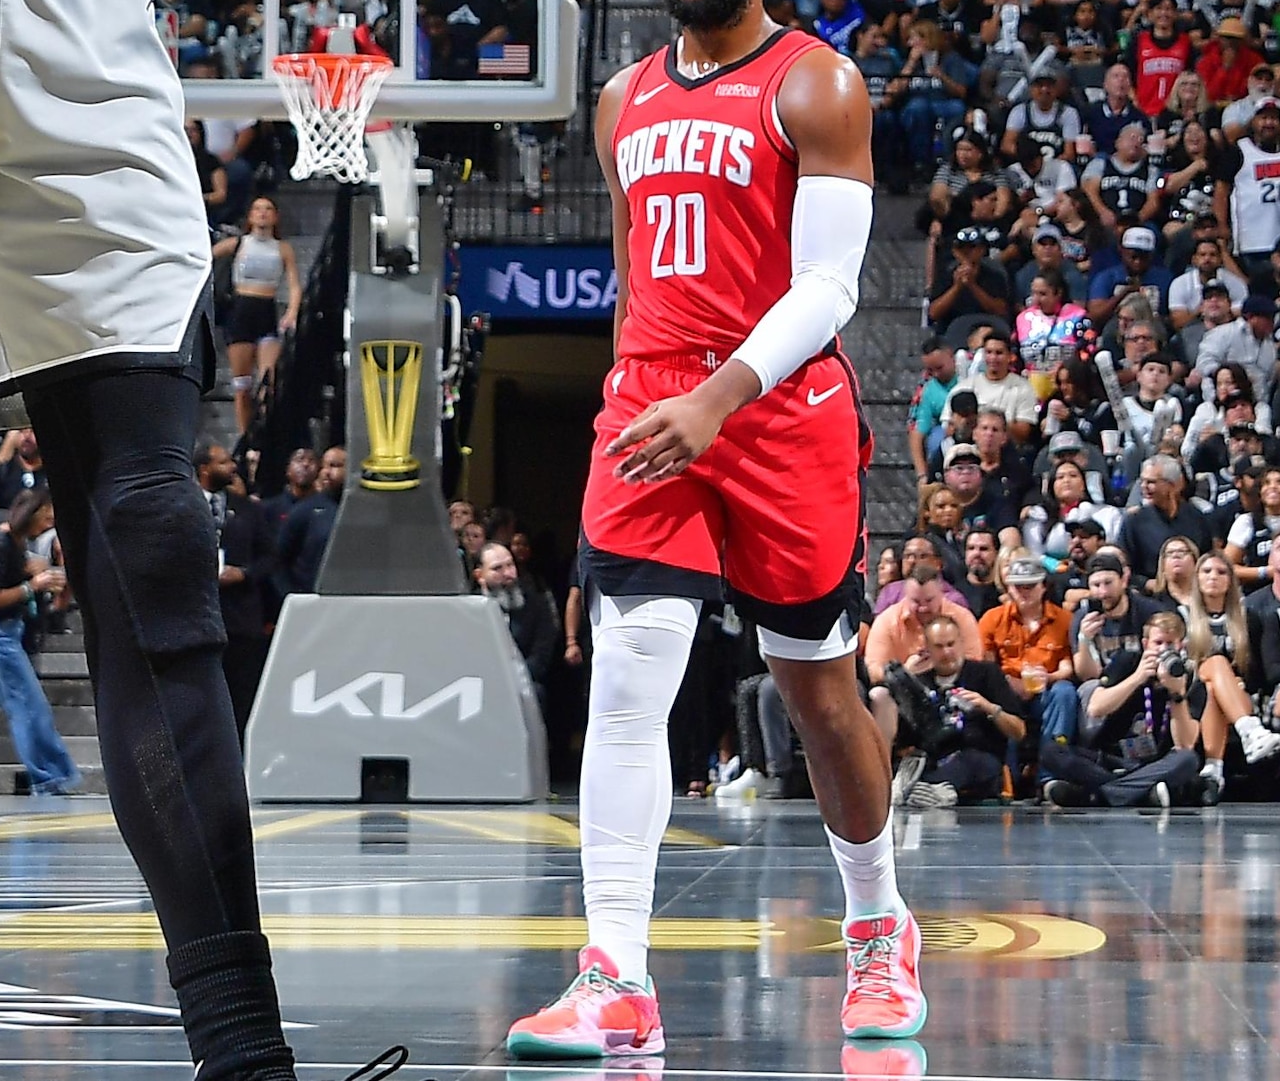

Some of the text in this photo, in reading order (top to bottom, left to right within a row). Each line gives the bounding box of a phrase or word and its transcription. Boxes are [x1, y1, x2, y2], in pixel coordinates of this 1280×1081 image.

[616, 118, 756, 195] ROCKETS
[645, 192, 707, 279] 20
[292, 669, 484, 722] KIA
